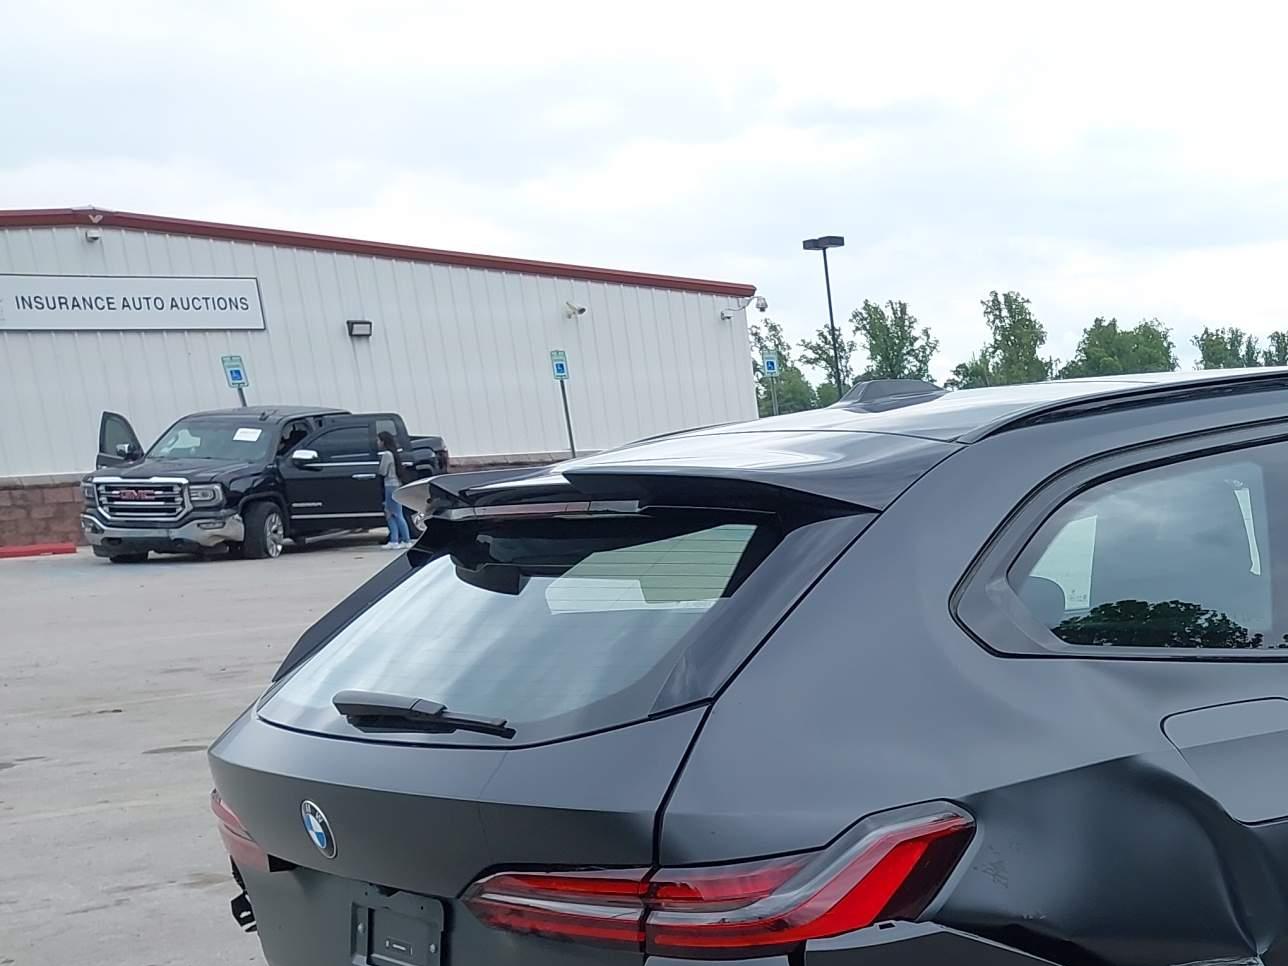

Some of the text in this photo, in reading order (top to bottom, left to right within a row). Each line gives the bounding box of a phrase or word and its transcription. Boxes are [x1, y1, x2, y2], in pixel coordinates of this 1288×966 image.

[14, 295, 249, 311] INSURANCE AUTO AUCTIONS
